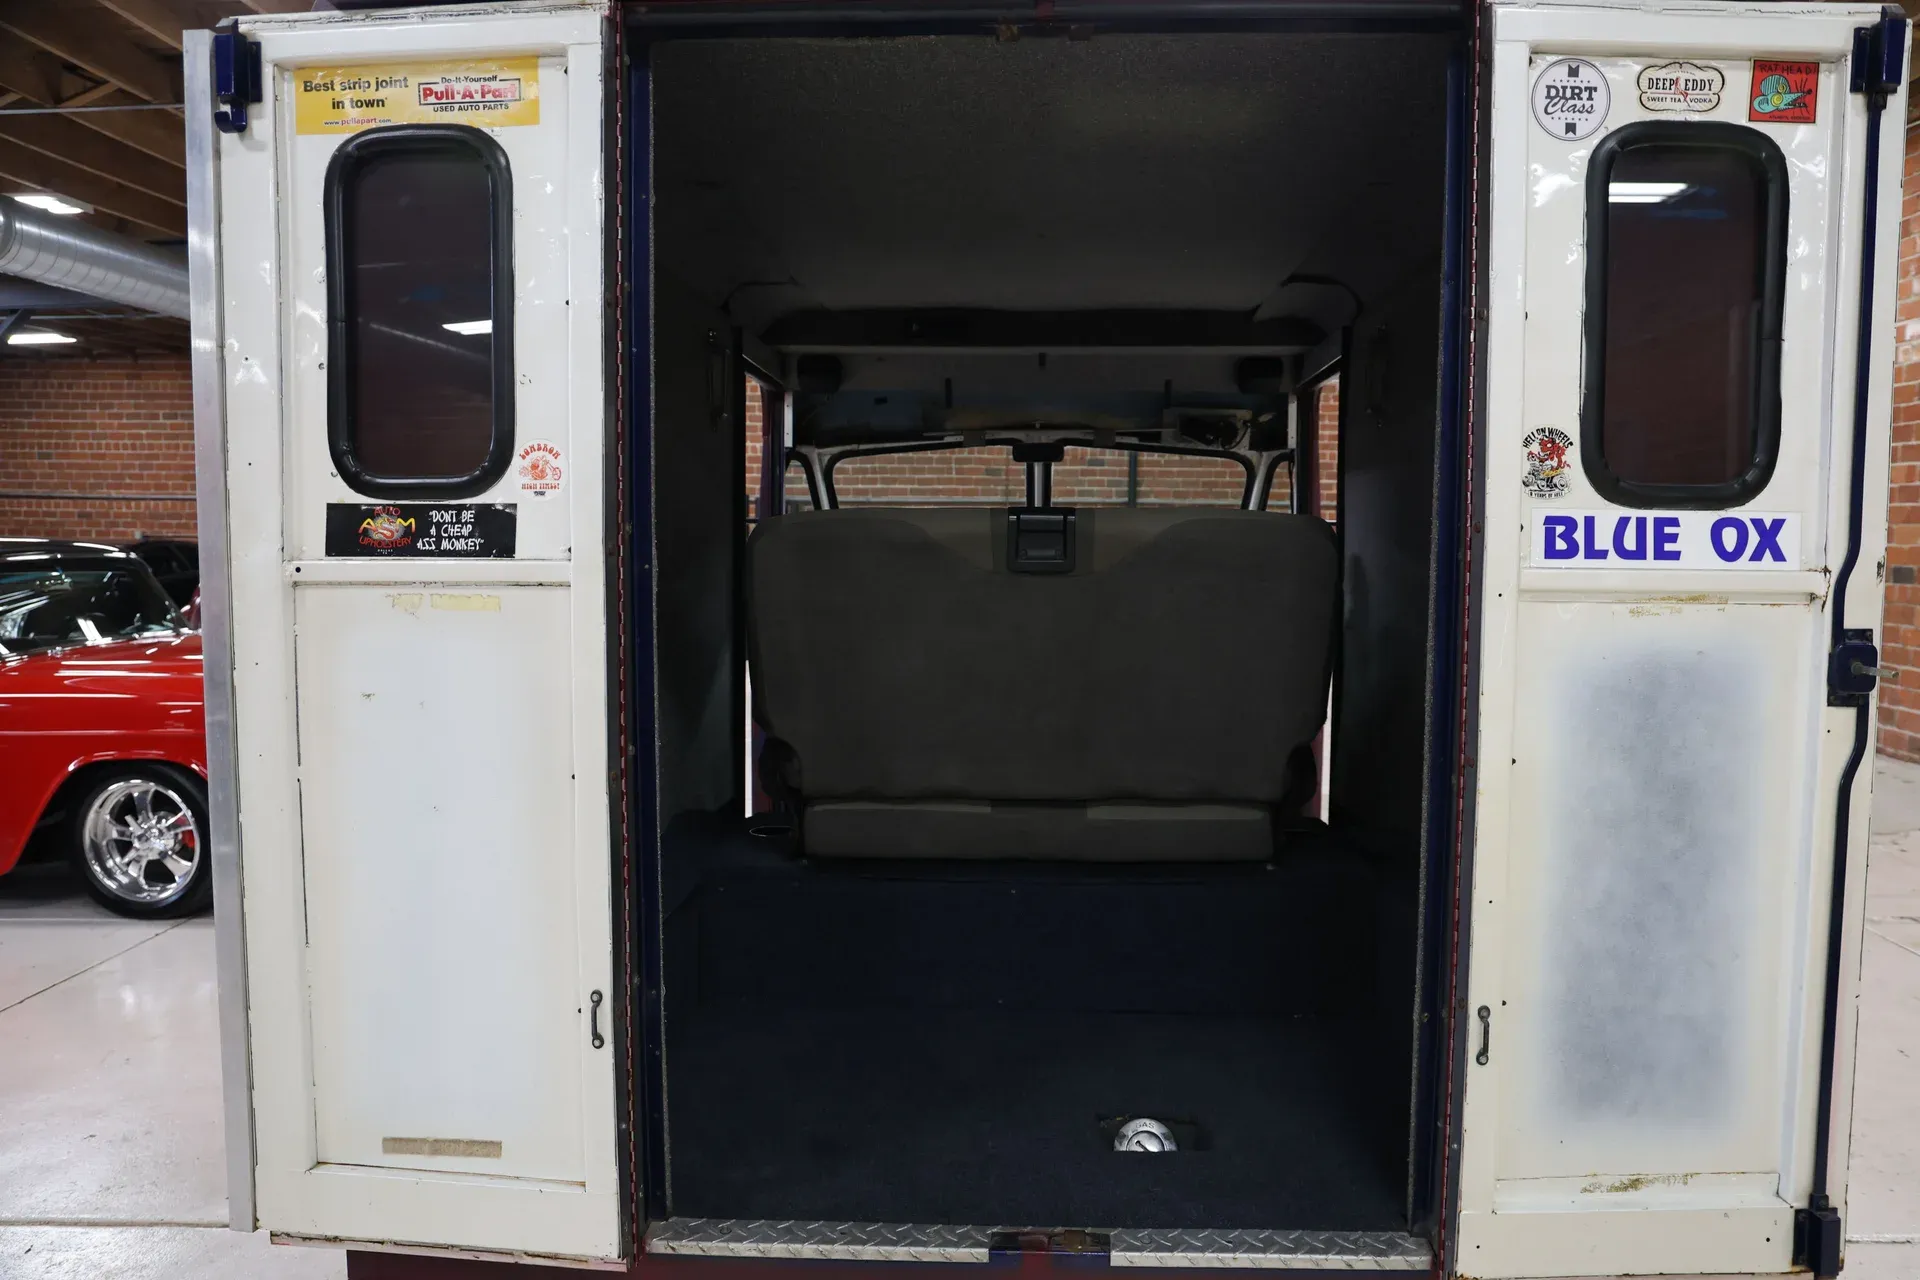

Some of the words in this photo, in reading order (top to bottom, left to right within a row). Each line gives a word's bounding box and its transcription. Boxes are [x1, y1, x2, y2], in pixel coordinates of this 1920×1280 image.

[303, 80, 335, 92] Best
[340, 78, 371, 92] strip
[374, 76, 409, 91] joint
[440, 75, 498, 84] Do-It-Yourself
[1648, 77, 1675, 90] DEEP
[1684, 78, 1714, 91] EDDY
[1545, 84, 1598, 101] DIRT
[331, 97, 345, 109] in
[433, 105, 455, 113] USED
[457, 104, 481, 112] AUTO
[482, 103, 510, 111] PARTS
[1544, 96, 1596, 116] Class
[324, 118, 392, 126] www.pullapart.com
[1522, 431, 1537, 449] HELL
[1536, 427, 1546, 435] ON
[1547, 427, 1574, 449] WHEELS
[461, 510, 475, 523] BE
[430, 524, 436, 537] A
[440, 523, 473, 537] CHEAP
[359, 535, 412, 549] UPHOLSTERY
[416, 538, 436, 551] ASS
[1543, 515, 1682, 561] BLUE
[1710, 516, 1787, 563] OX
[1135, 1121, 1156, 1130] GAS
